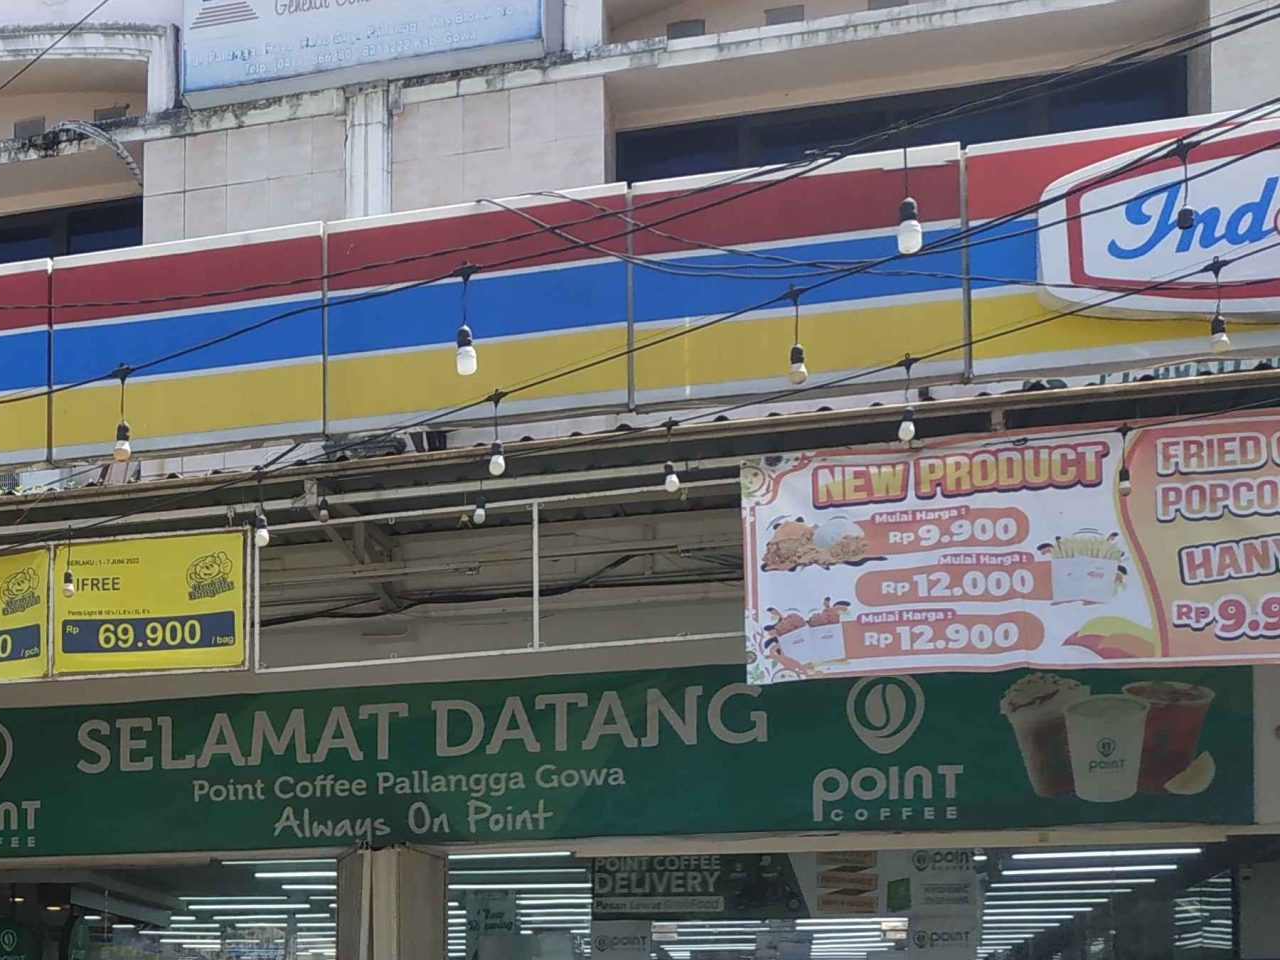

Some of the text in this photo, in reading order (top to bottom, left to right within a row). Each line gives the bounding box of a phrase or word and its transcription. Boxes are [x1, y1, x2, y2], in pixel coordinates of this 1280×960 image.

[1107, 176, 1280, 260] Ind
[1159, 434, 1263, 473] FRIED
[814, 445, 1107, 505] NEW PRODUCT
[875, 511, 913, 525] Mulai
[915, 509, 956, 523] Harga
[889, 516, 1018, 547] Rp 9.900
[939, 553, 977, 566] Mulai
[979, 552, 1018, 567] Harga
[74, 577, 121, 592] IFREE
[881, 568, 1035, 598] Rp 12.000
[861, 611, 899, 625] Mulai
[903, 609, 943, 624] Harga
[1176, 602, 1211, 625] Rp
[66, 619, 201, 649] Rp 69.900
[216, 634, 234, 645] bag
[864, 621, 1020, 651] Rp 12.900
[24, 647, 40, 658] pch
[76, 683, 768, 774] SELAMAT DATANG
[192, 764, 626, 802] Point Coffee Pallangga Gowa
[273, 799, 554, 842] Always On Point
[830, 805, 959, 822] COFFEE
[594, 855, 721, 871] POINT COFFEE
[594, 870, 721, 895] DELIVERY
